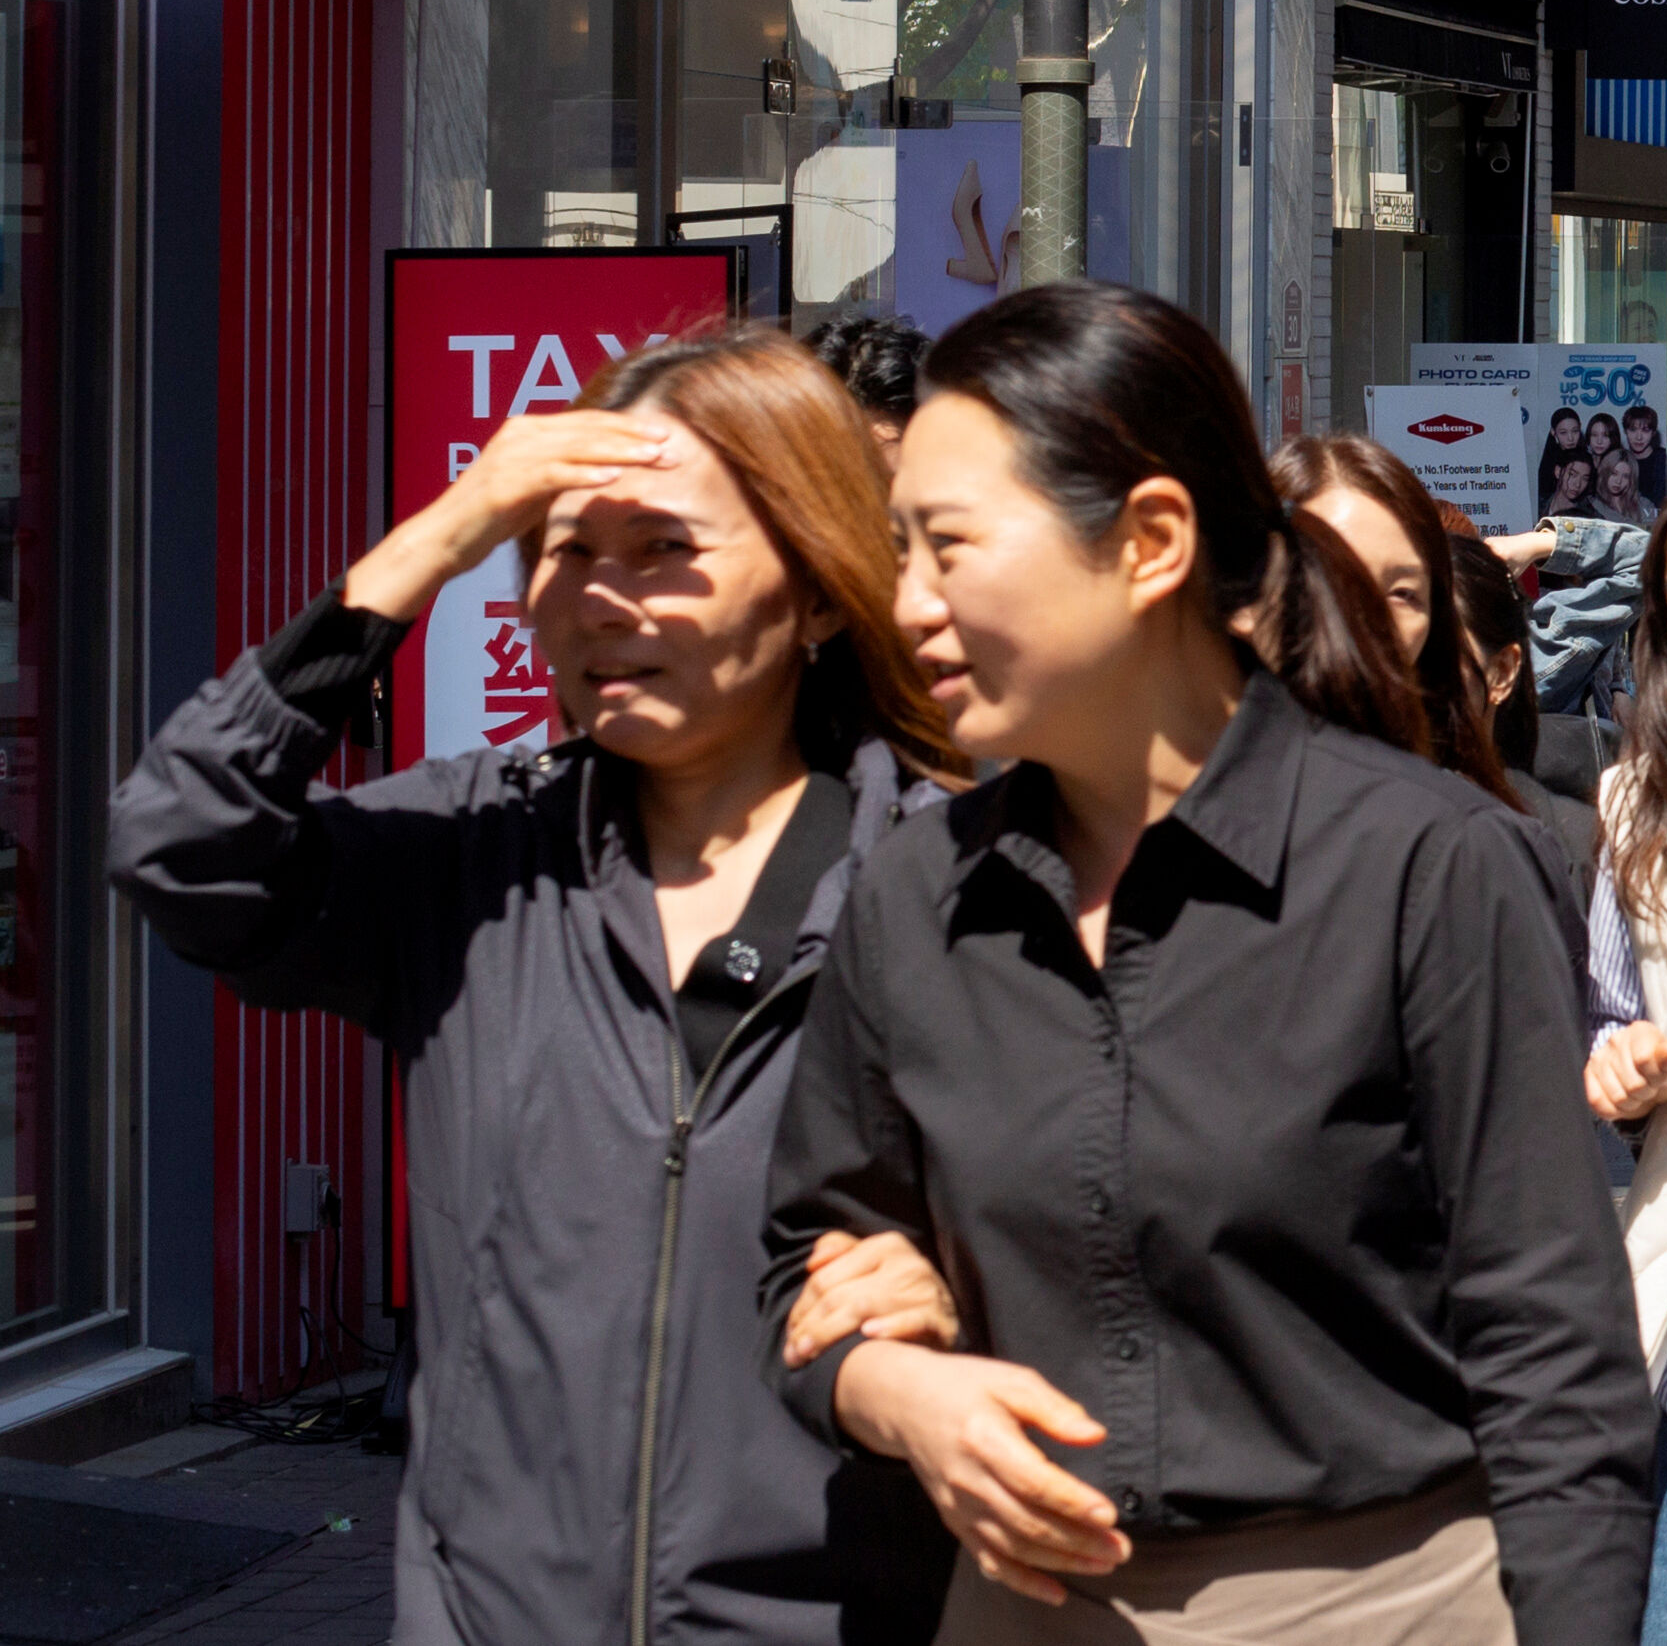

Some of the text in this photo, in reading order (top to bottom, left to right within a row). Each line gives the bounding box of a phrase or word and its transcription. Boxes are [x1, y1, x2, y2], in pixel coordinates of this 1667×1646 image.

[1418, 369, 1531, 379] PHOTO CARD
[1560, 382, 1579, 394] UP
[1560, 395, 1579, 406] TO
[1418, 423, 1474, 435] Kumkang
[1484, 463, 1510, 474] Brand
[1432, 480, 1457, 491] Years
[1459, 480, 1468, 491] of
[1469, 480, 1507, 491] Tradition
